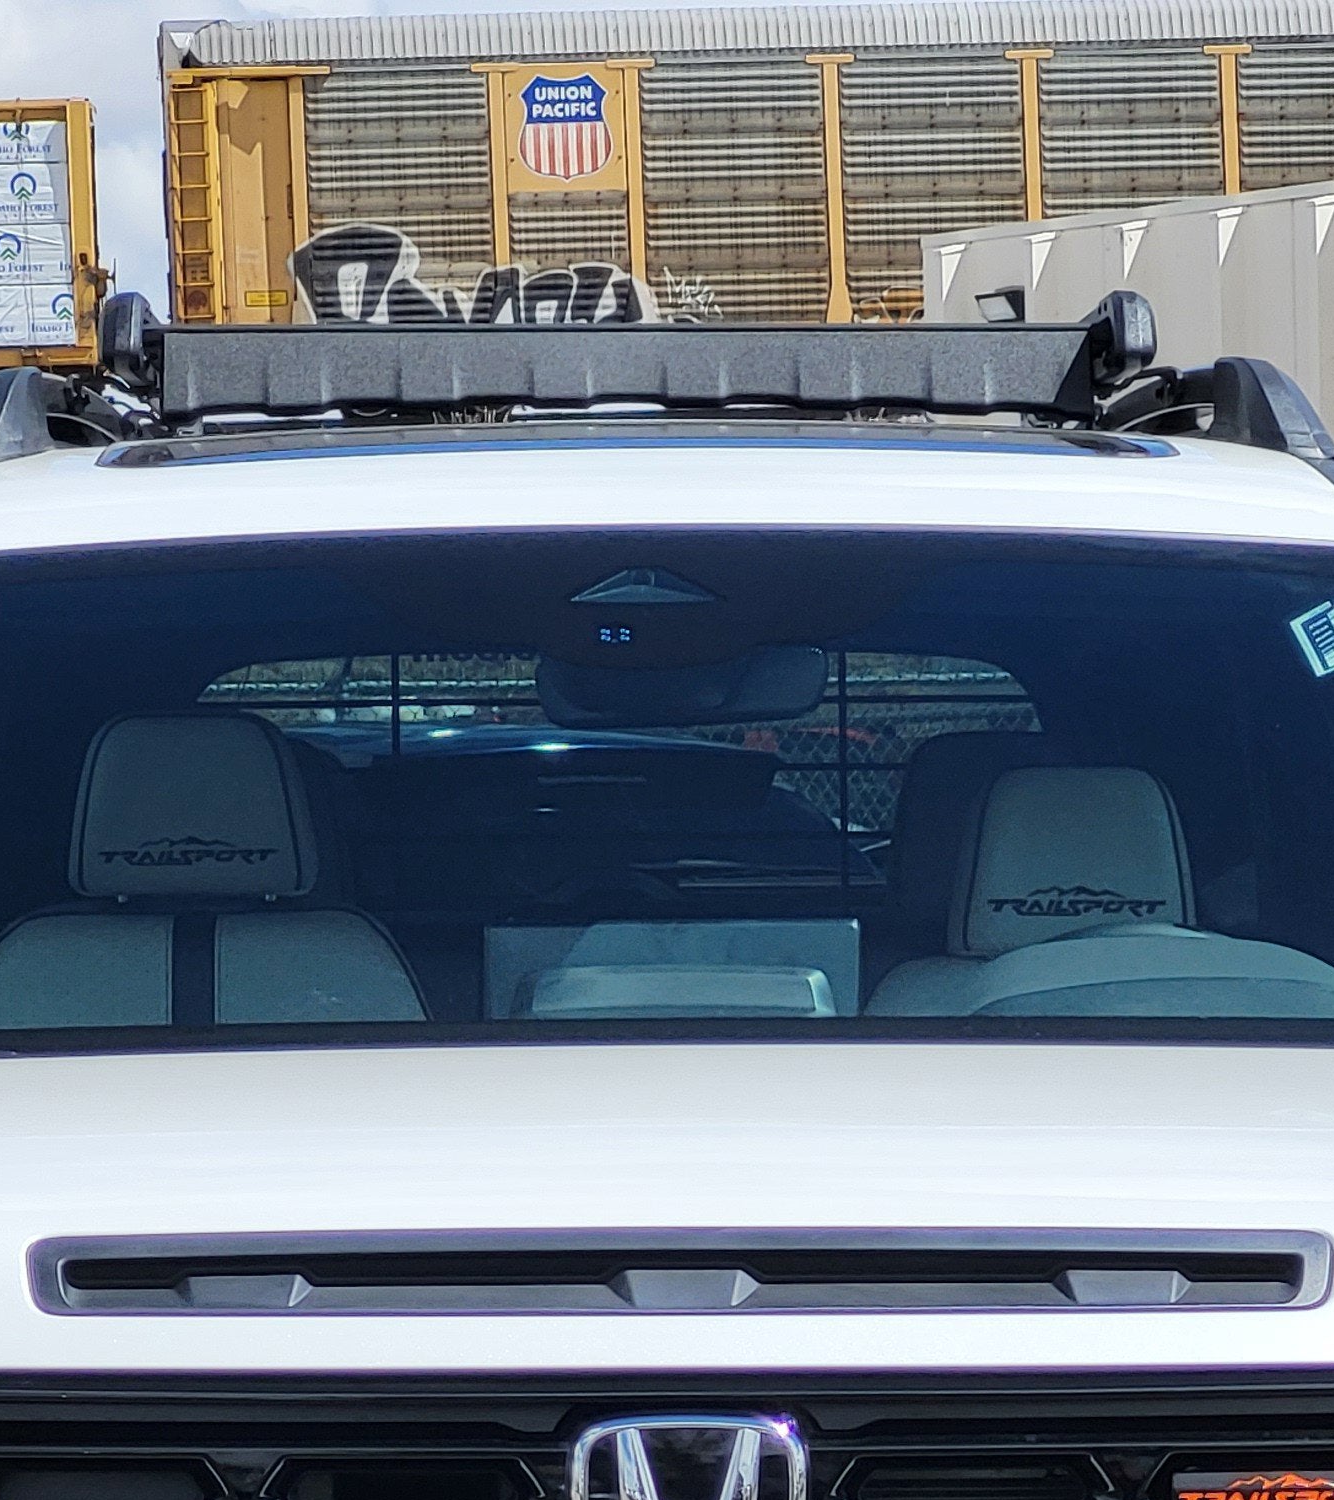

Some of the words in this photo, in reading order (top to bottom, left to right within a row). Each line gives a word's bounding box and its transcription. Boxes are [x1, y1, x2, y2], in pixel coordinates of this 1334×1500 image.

[533, 84, 593, 103] UNION
[531, 101, 598, 120] PACIFIC
[8, 262, 45, 274] FOREST
[98, 848, 279, 867] TRAILSPORT
[987, 898, 1167, 918] TRAILSPORT
